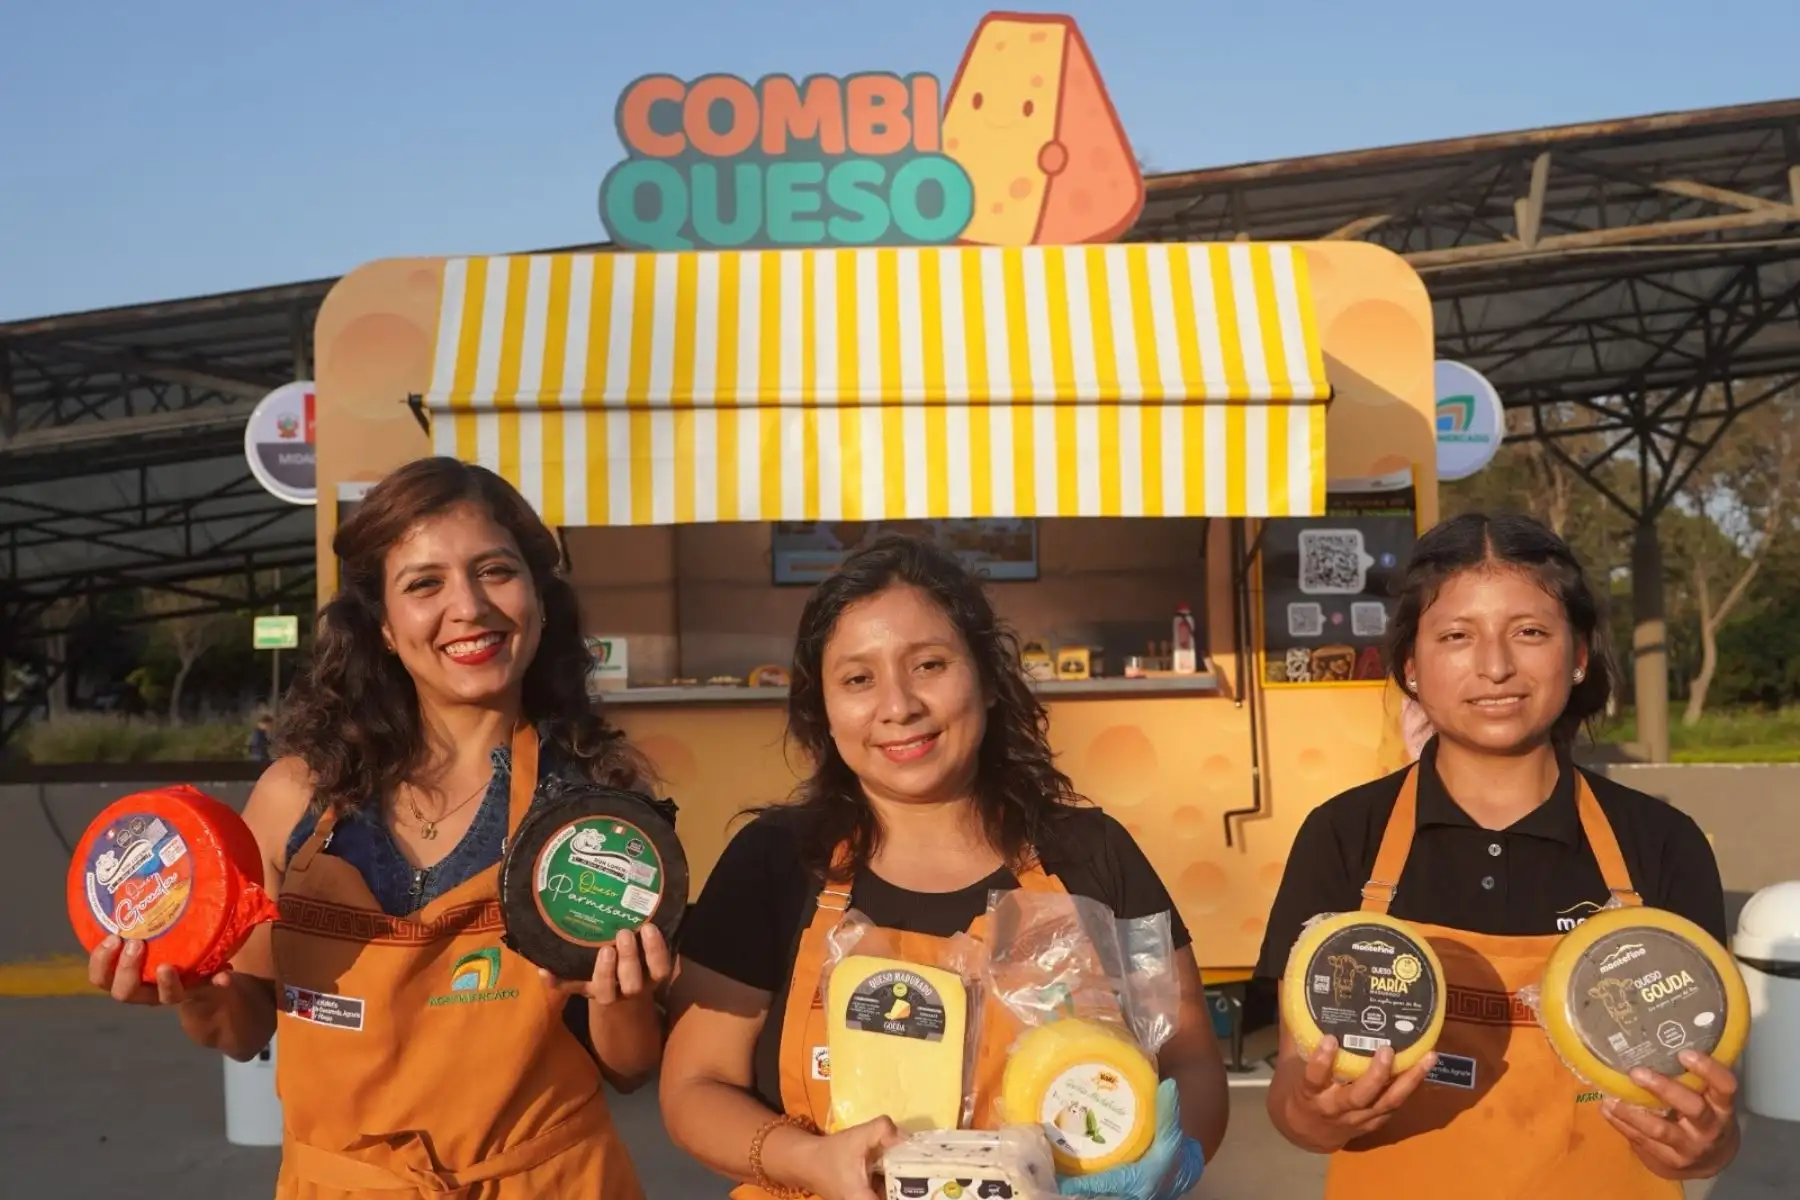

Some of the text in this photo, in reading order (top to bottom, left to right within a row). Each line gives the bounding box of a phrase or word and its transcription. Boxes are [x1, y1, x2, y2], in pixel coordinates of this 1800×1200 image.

[622, 76, 941, 157] COMBI
[606, 157, 974, 250] QUESO
[1437, 434, 1490, 443] MERCADO
[579, 871, 619, 898] Queso
[116, 872, 178, 931] Gouda
[548, 874, 643, 923] Parmesano
[1352, 943, 1395, 955] montefino
[1600, 947, 1647, 974] montefino
[868, 971, 933, 997] QUESO MADURADO
[1371, 966, 1392, 976] QUESO
[1634, 970, 1662, 989] QUESO
[1370, 976, 1409, 994] PARIA
[1640, 969, 1695, 1003] GOUDA
[883, 1021, 906, 1033] GOUDA
